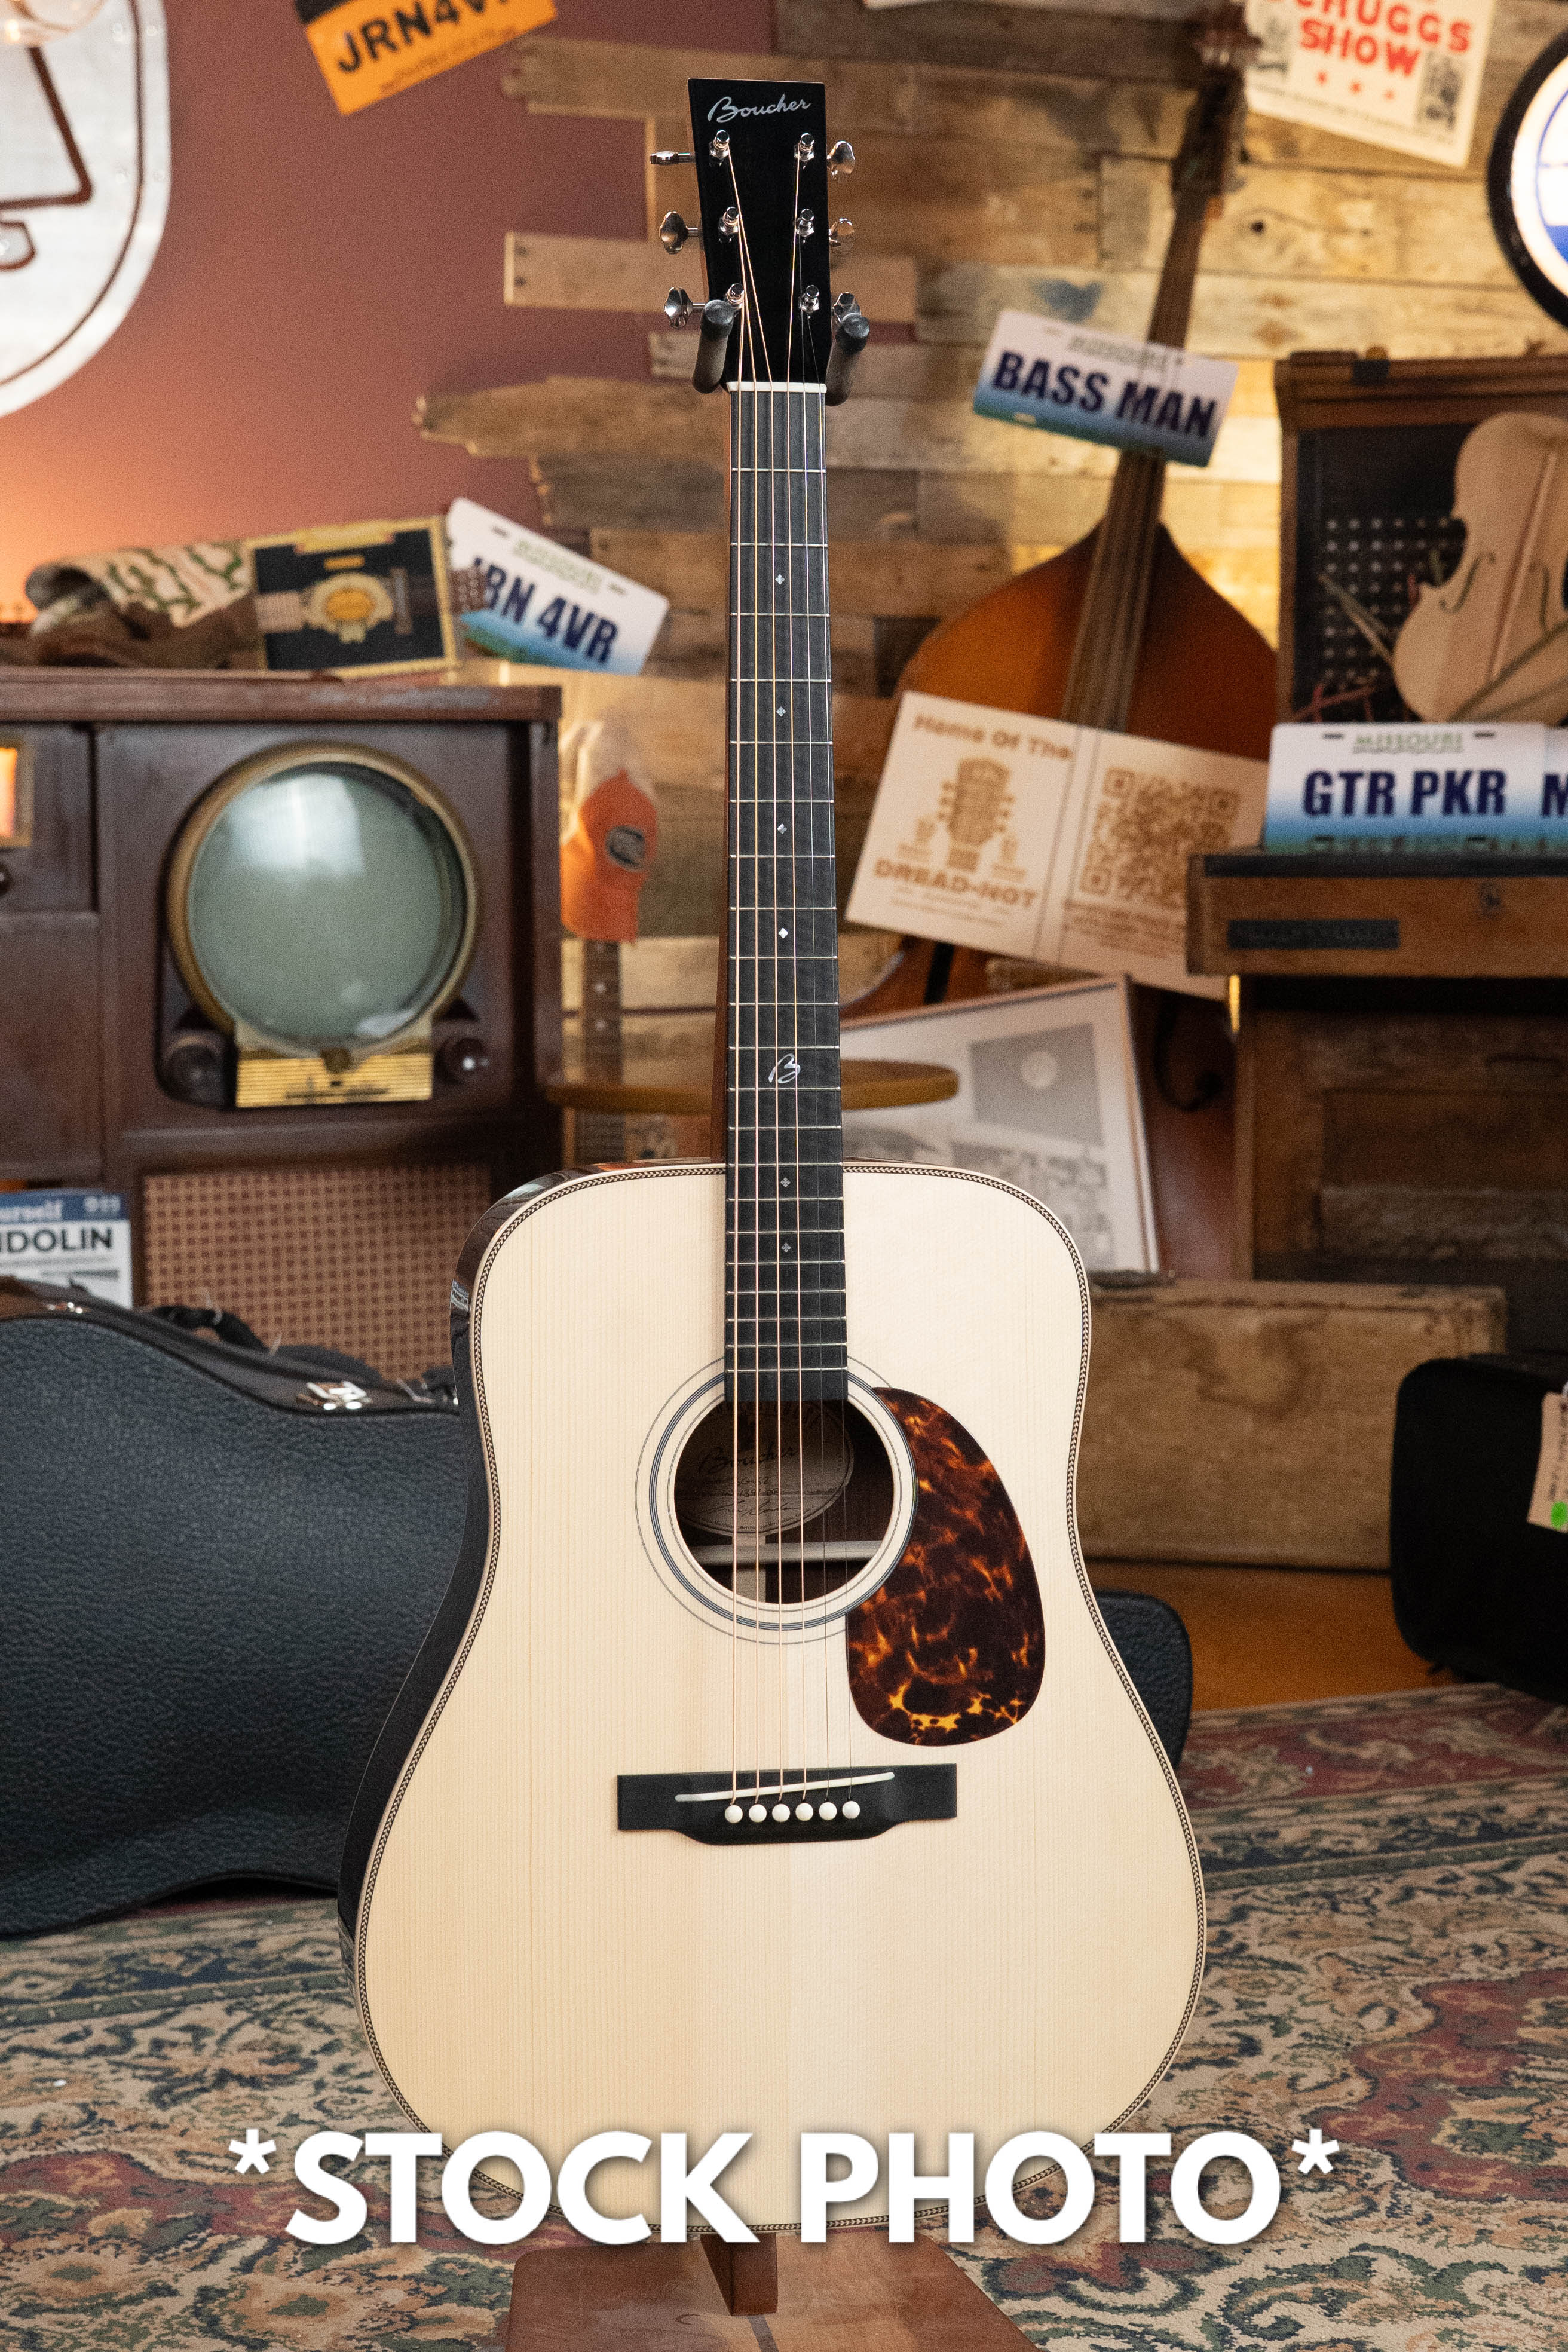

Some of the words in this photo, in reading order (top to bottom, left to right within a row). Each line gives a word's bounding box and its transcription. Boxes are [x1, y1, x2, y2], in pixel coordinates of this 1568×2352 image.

[336, 0, 508, 74] JRN4
[1299, 18, 1420, 76] SHOW
[707, 93, 811, 123] Boucher
[992, 350, 1110, 413] BASS
[1116, 380, 1217, 437] MAN
[474, 557, 537, 624] RN
[537, 596, 619, 665] 4VR
[1028, 736, 1074, 760] The
[1304, 770, 1396, 817] GTR
[1410, 770, 1506, 817] PKR
[0, 1226, 112, 1253] DOLIN
